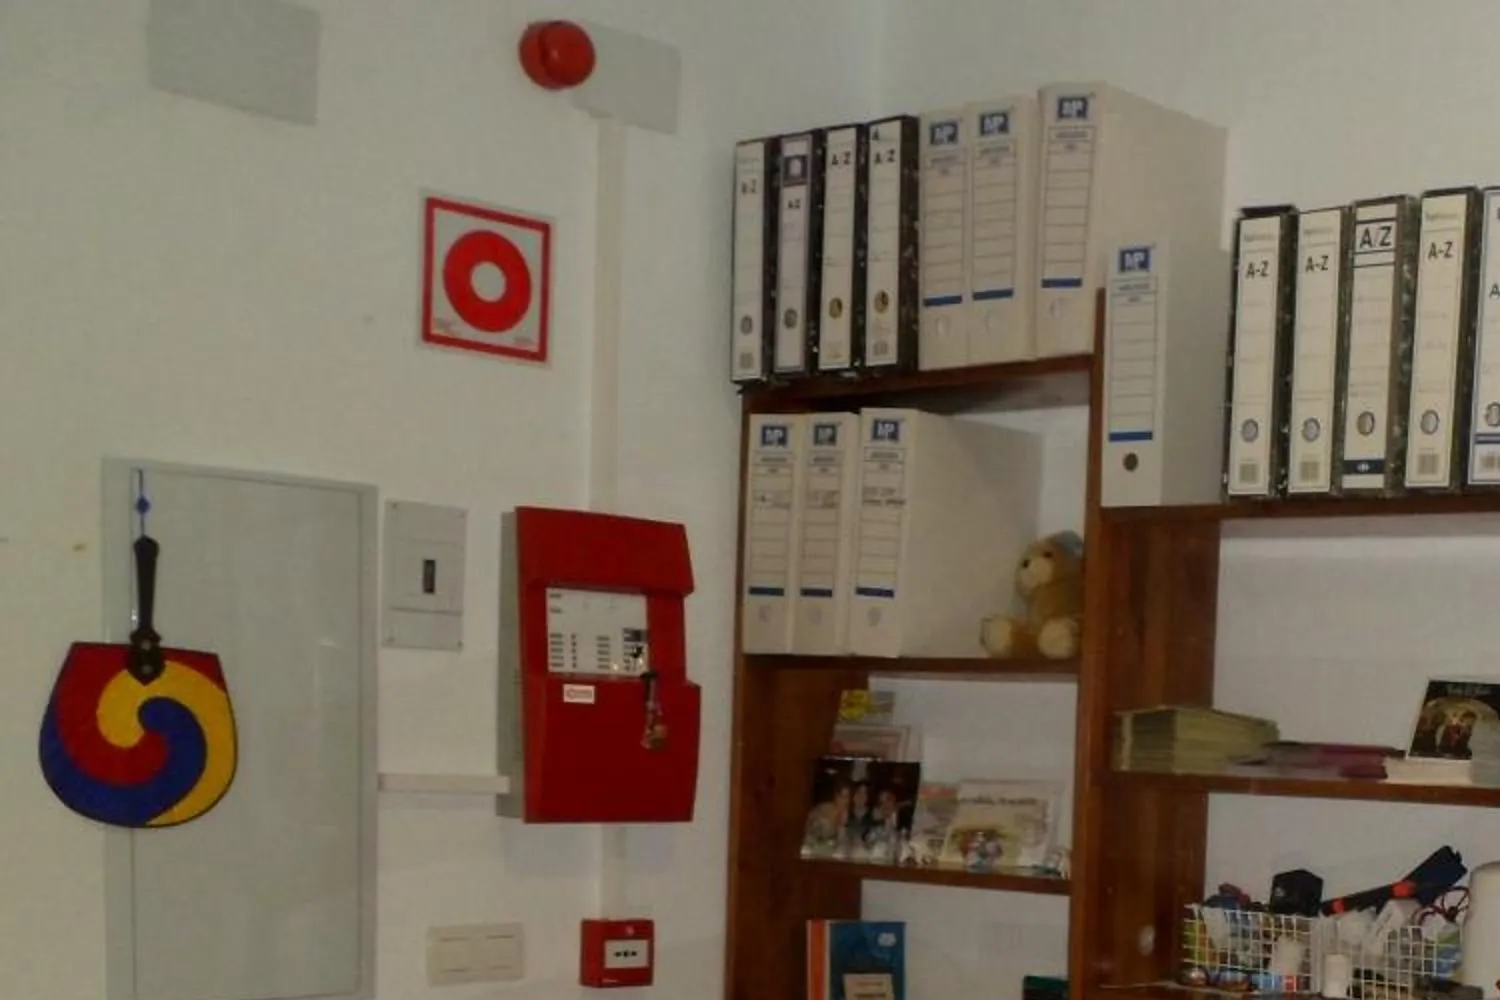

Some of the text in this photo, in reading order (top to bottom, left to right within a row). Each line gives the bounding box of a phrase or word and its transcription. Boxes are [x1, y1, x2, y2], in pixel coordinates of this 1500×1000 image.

[1427, 241, 1454, 260] A-Z
[1244, 260, 1270, 278] A-Z
[1304, 254, 1330, 273] A-Z
